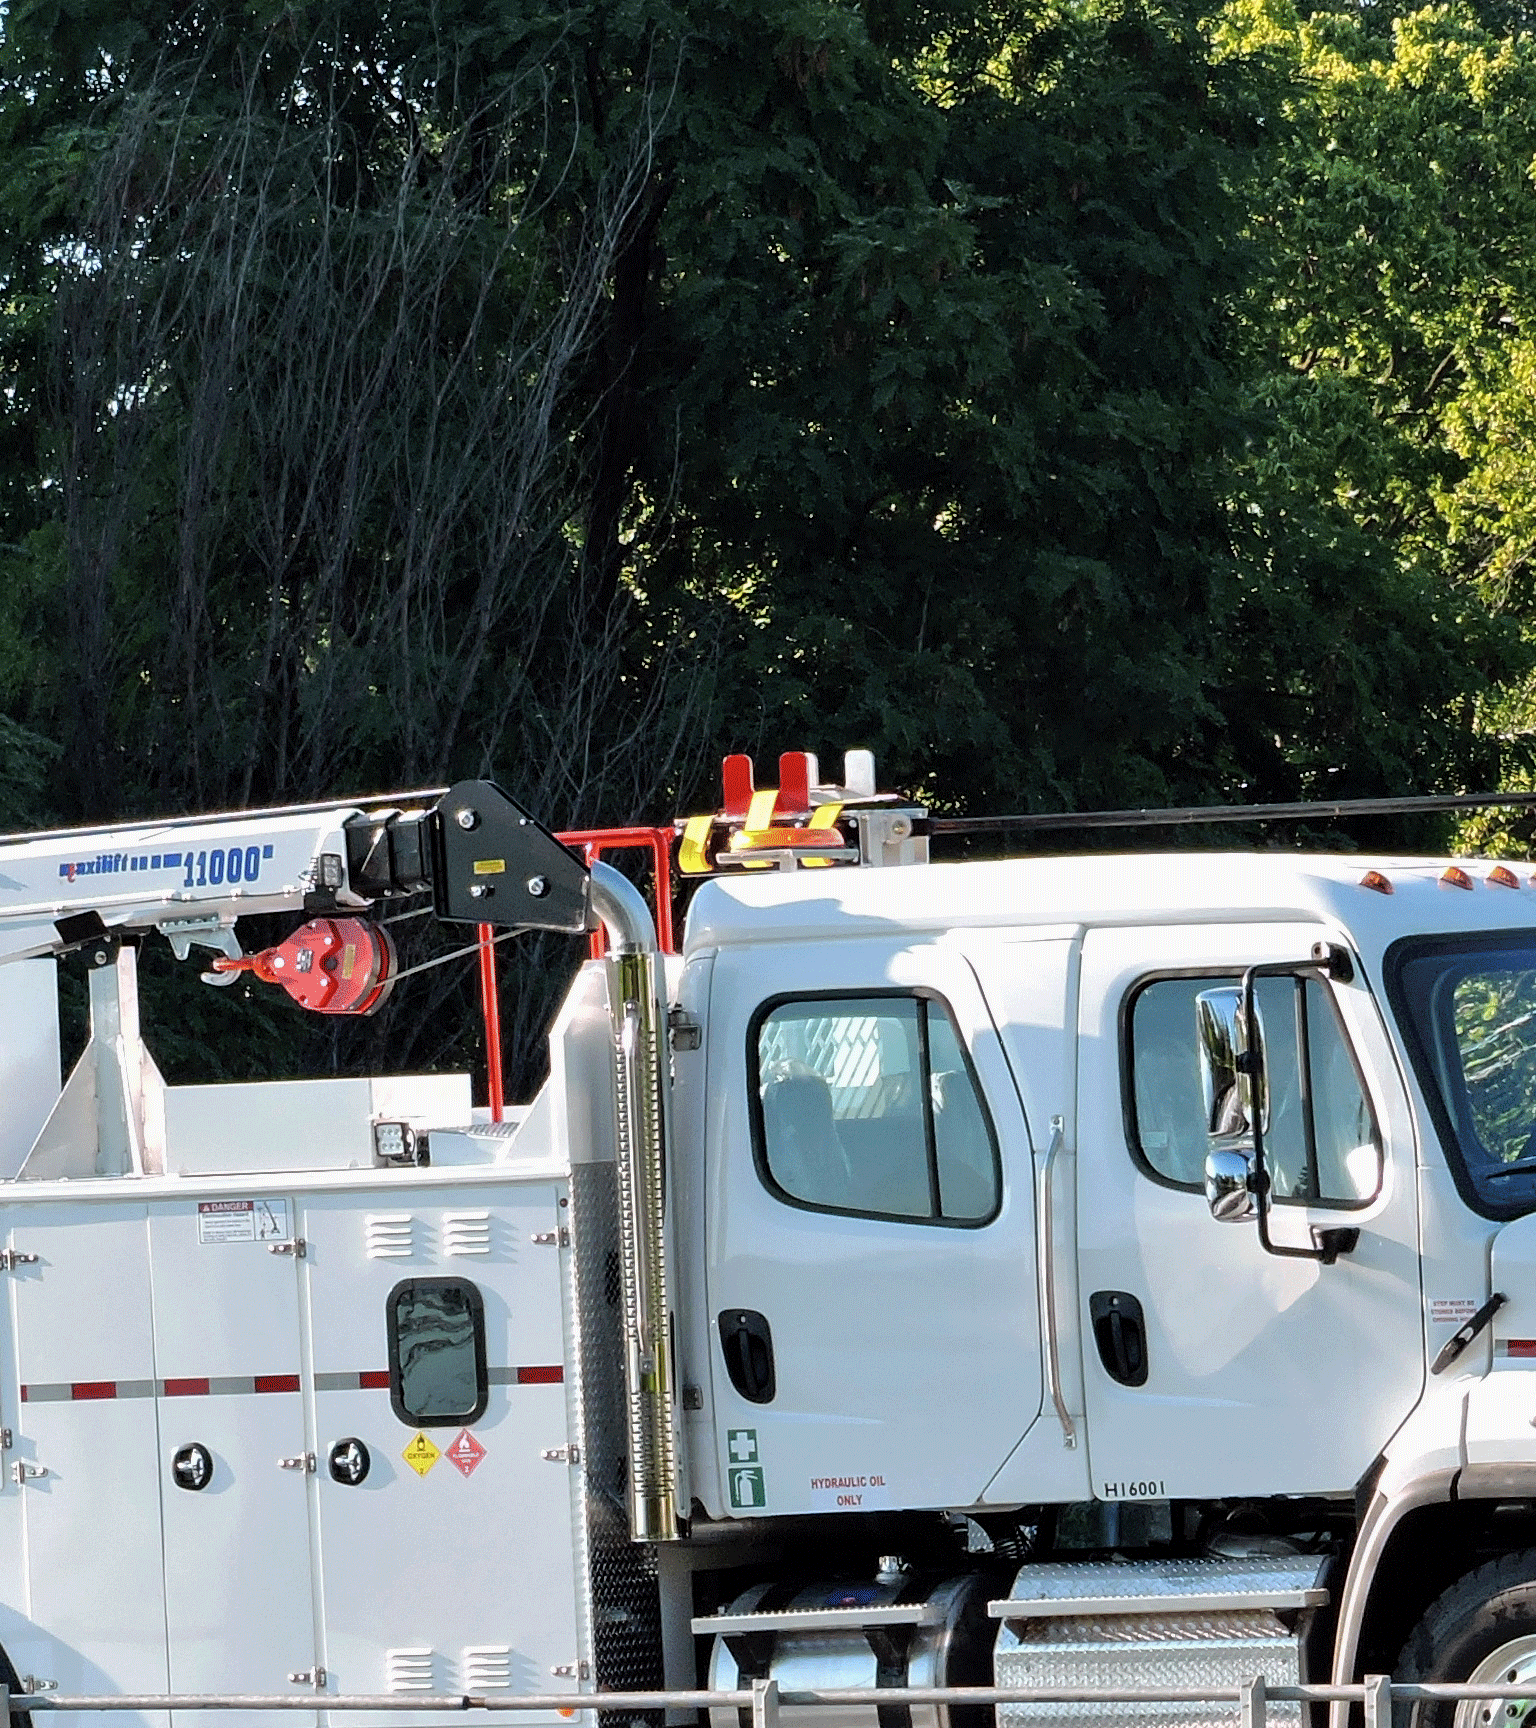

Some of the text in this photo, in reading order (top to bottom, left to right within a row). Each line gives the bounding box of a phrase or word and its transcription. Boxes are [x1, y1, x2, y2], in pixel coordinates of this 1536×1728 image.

[211, 1202, 249, 1212] DANGER
[811, 1475, 886, 1489] HYDRAULIC OIL
[1104, 1481, 1165, 1497] H16001
[836, 1494, 863, 1506] ONLY
